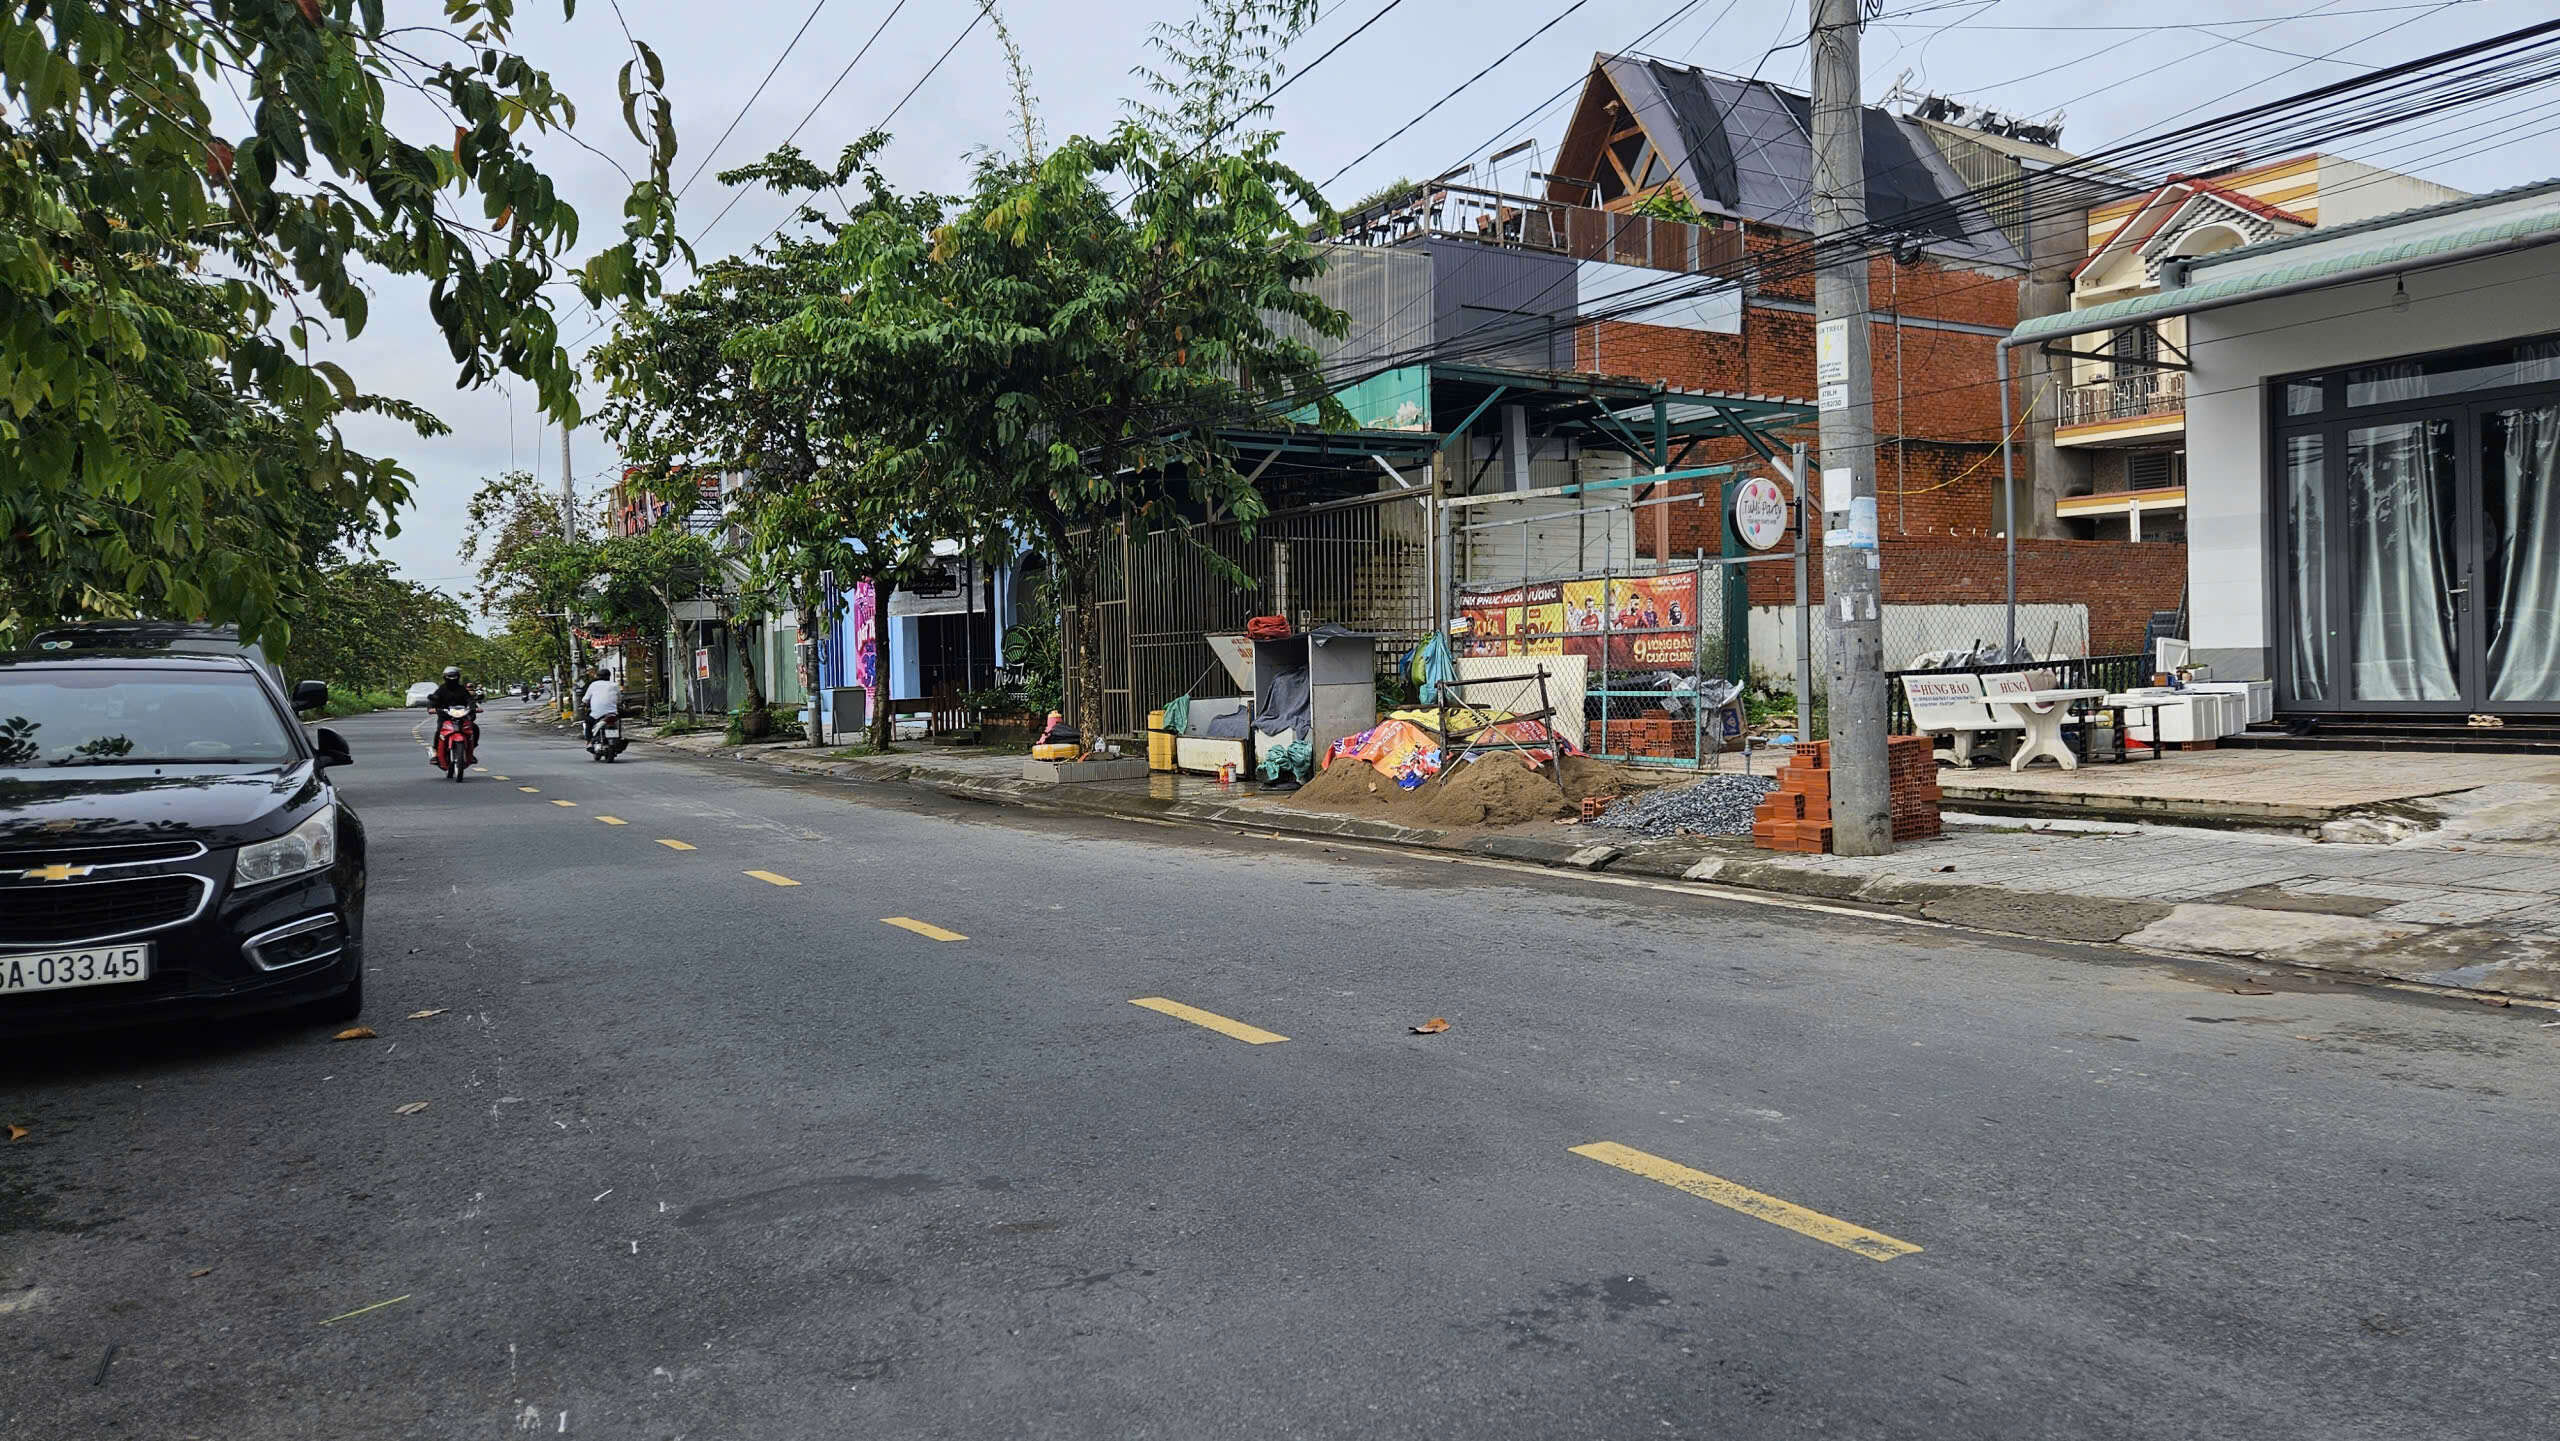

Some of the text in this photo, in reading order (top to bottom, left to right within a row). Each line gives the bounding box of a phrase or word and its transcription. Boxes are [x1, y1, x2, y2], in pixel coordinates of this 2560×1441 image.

[1762, 501, 1782, 519] Party
[1514, 620, 1555, 646] 50%
[1633, 639, 1647, 663] 9
